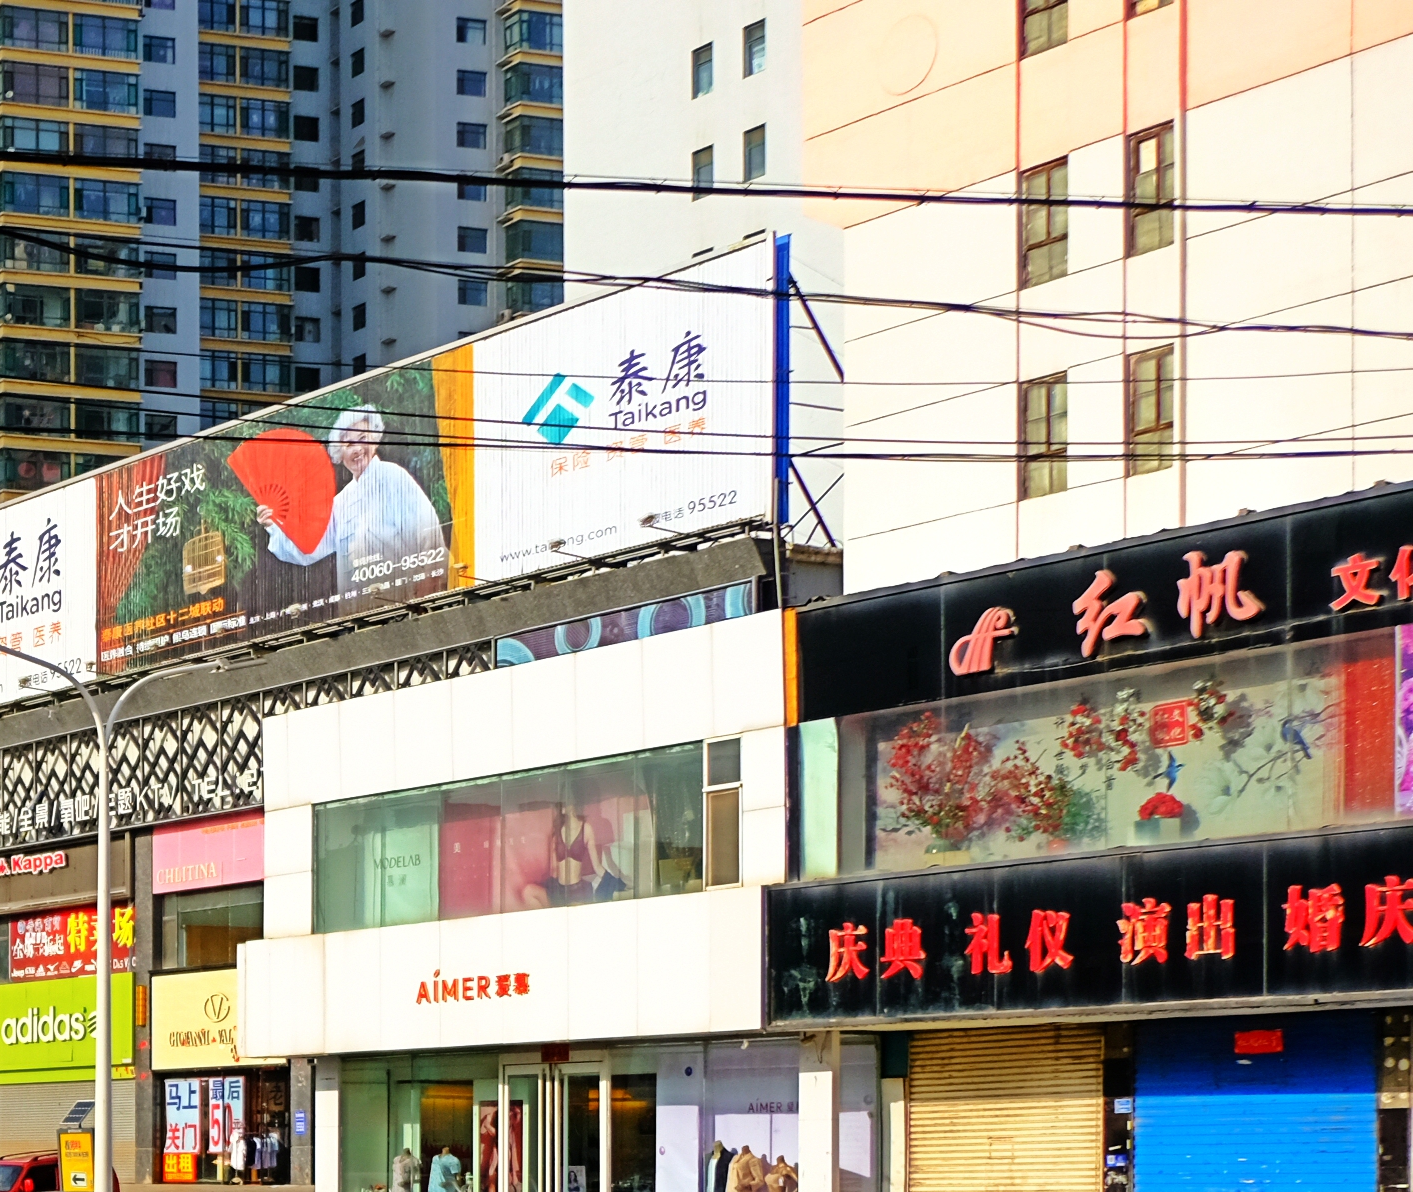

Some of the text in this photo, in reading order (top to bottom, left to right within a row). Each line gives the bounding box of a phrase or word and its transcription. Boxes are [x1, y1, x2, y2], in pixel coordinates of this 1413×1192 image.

[608, 330, 707, 406] 泰康
[608, 389, 707, 429] Taikang
[550, 450, 591, 478] 保险
[663, 417, 707, 445] 医养
[109, 463, 206, 521] 人生好戏
[687, 490, 738, 515] 95522
[109, 506, 182, 552] 才开场
[350, 547, 445, 583] 40060-95522
[101, 597, 225, 643] 泰康医养社区十二城联动
[1072, 550, 1264, 659] 红帆
[33, 621, 63, 648] 医养
[10, 850, 67, 875] Kappa
[156, 861, 217, 885] CHLITINA
[373, 853, 421, 870] MODELAB
[825, 875, 1413, 984] 庆典 礼仪 演出 婚庆
[1, 1006, 87, 1046] adidas
[167, 1081, 199, 1111] 马上
[210, 1079, 242, 1101] 最后
[166, 1122, 198, 1151] 关门
[165, 1153, 193, 1173] 出租
